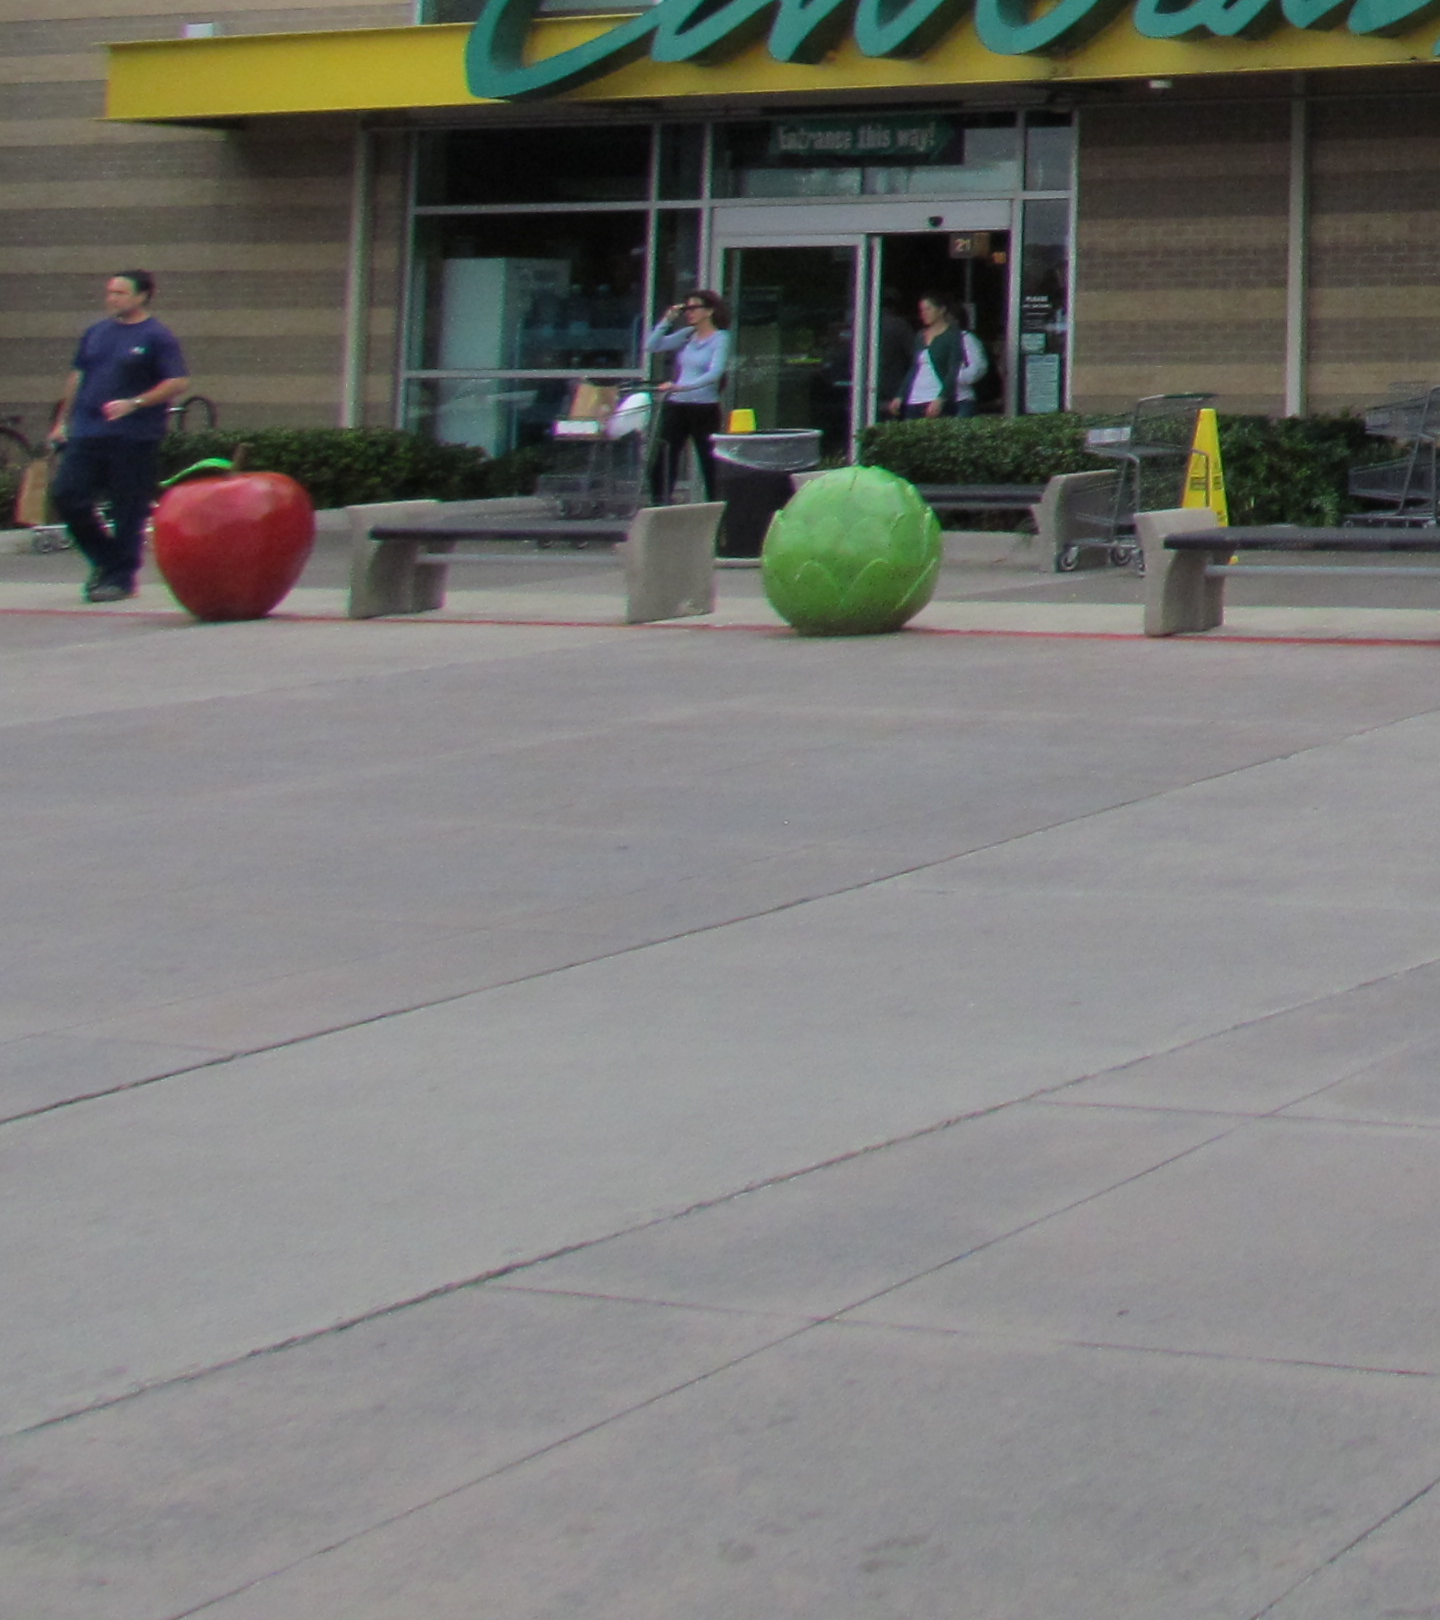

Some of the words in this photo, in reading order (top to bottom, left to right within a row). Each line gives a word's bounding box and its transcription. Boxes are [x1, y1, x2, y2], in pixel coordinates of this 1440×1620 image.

[778, 125, 853, 150] Entrance
[857, 123, 890, 149] this
[896, 121, 936, 152] way!
